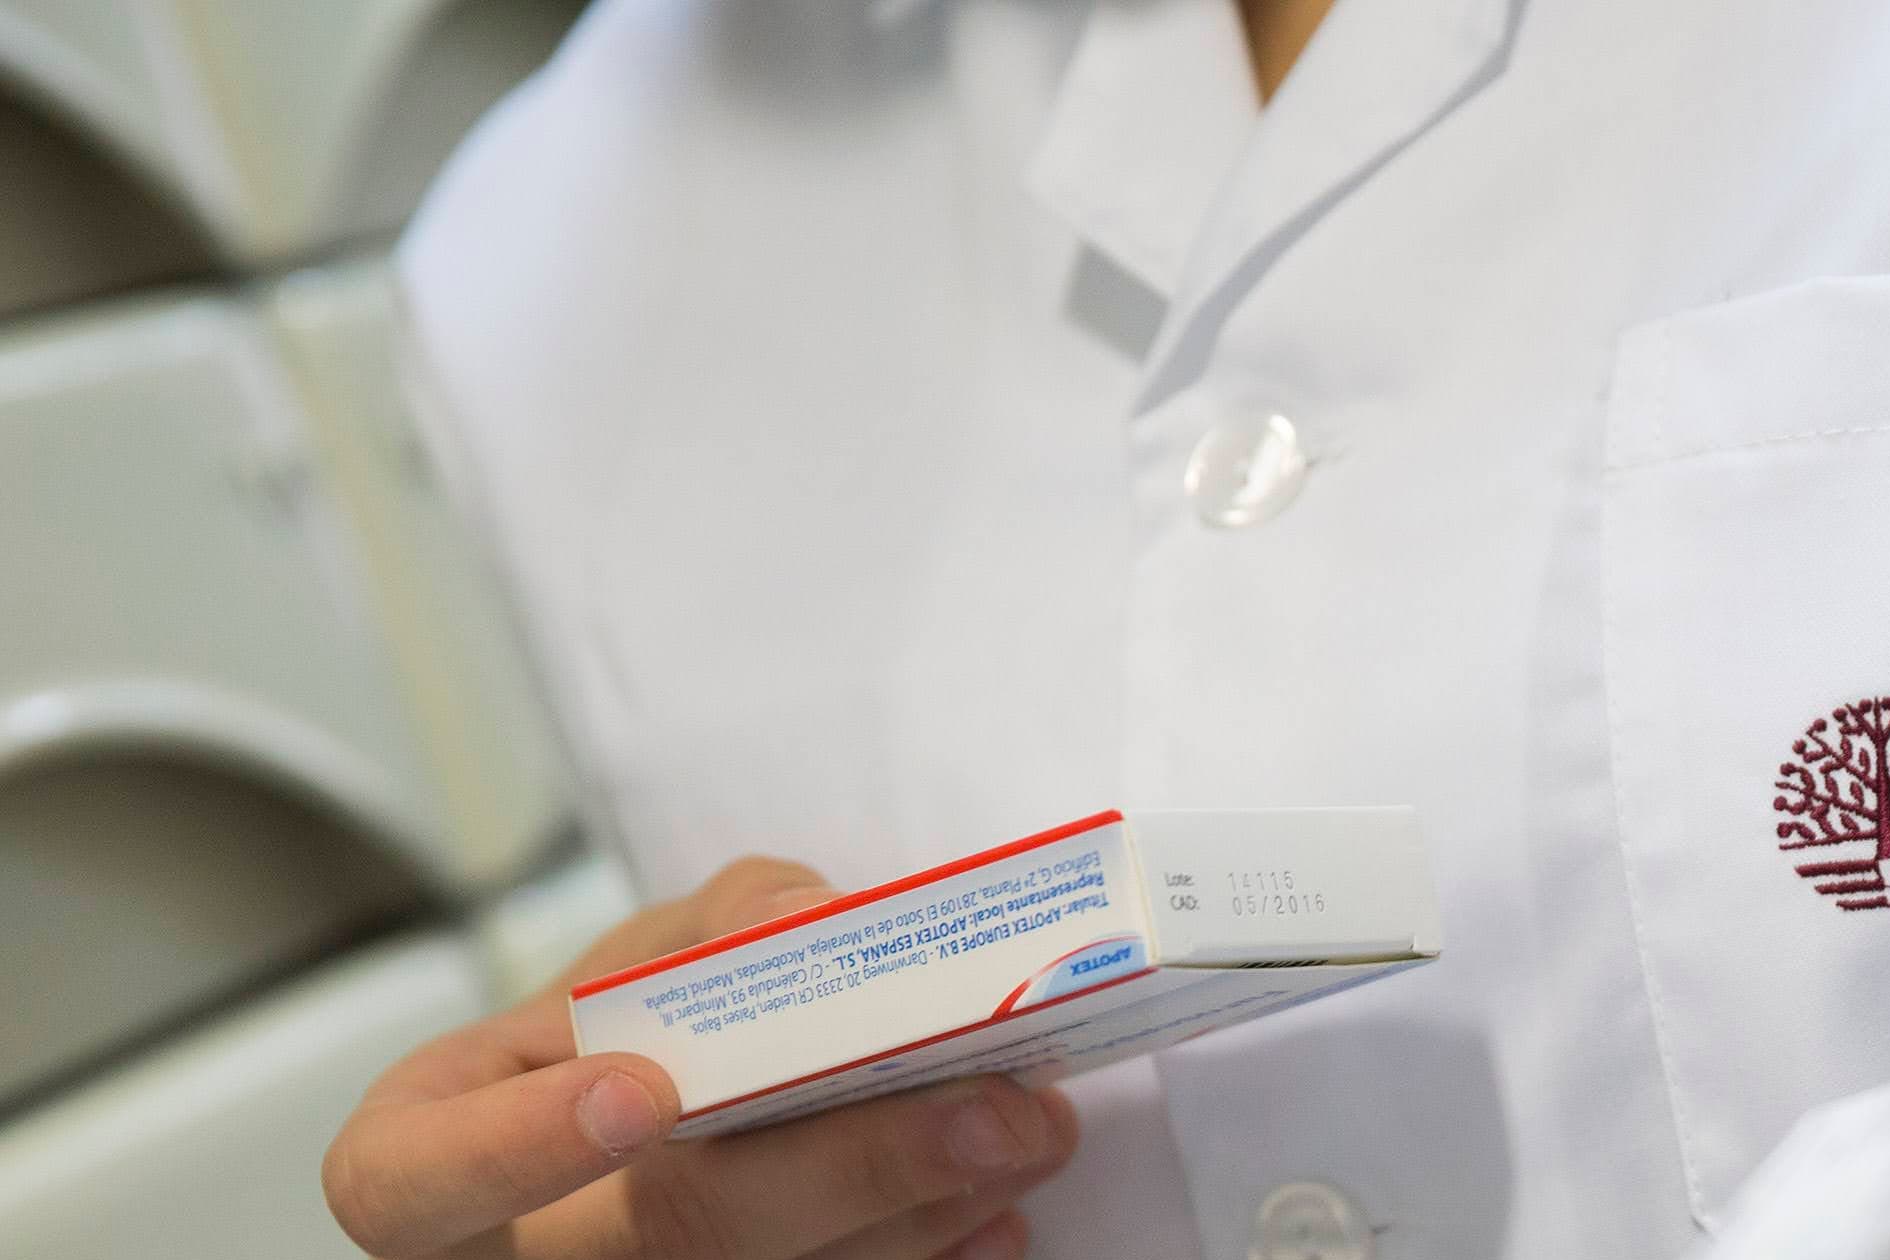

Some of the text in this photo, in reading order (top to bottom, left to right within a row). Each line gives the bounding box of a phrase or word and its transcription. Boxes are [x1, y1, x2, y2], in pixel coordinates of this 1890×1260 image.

[1052, 850, 1102, 880] Edificio
[939, 890, 978, 917] 28109
[1005, 868, 1105, 915] Representante
[1233, 894, 1326, 916] 05/2016
[895, 908, 924, 931] Soto
[926, 904, 938, 921] El
[968, 904, 1005, 928] local:
[1011, 906, 1063, 935] APOTEX
[863, 924, 876, 942] la
[877, 918, 894, 937] de
[913, 916, 968, 946] APOTEX
[960, 923, 1010, 952] EUROPE
[806, 925, 863, 960] Moraleja,
[856, 932, 913, 967] ESPAÑA,
[935, 939, 959, 960] B.V.
[733, 945, 806, 984] Alcobendas,
[831, 952, 855, 972] S.L.
[862, 946, 928, 983] Darwinweg
[1069, 946, 1132, 976] APOTEX
[747, 967, 808, 1001] Caléndula
[798, 986, 814, 1004] CR
[815, 976, 843, 998] 2333
